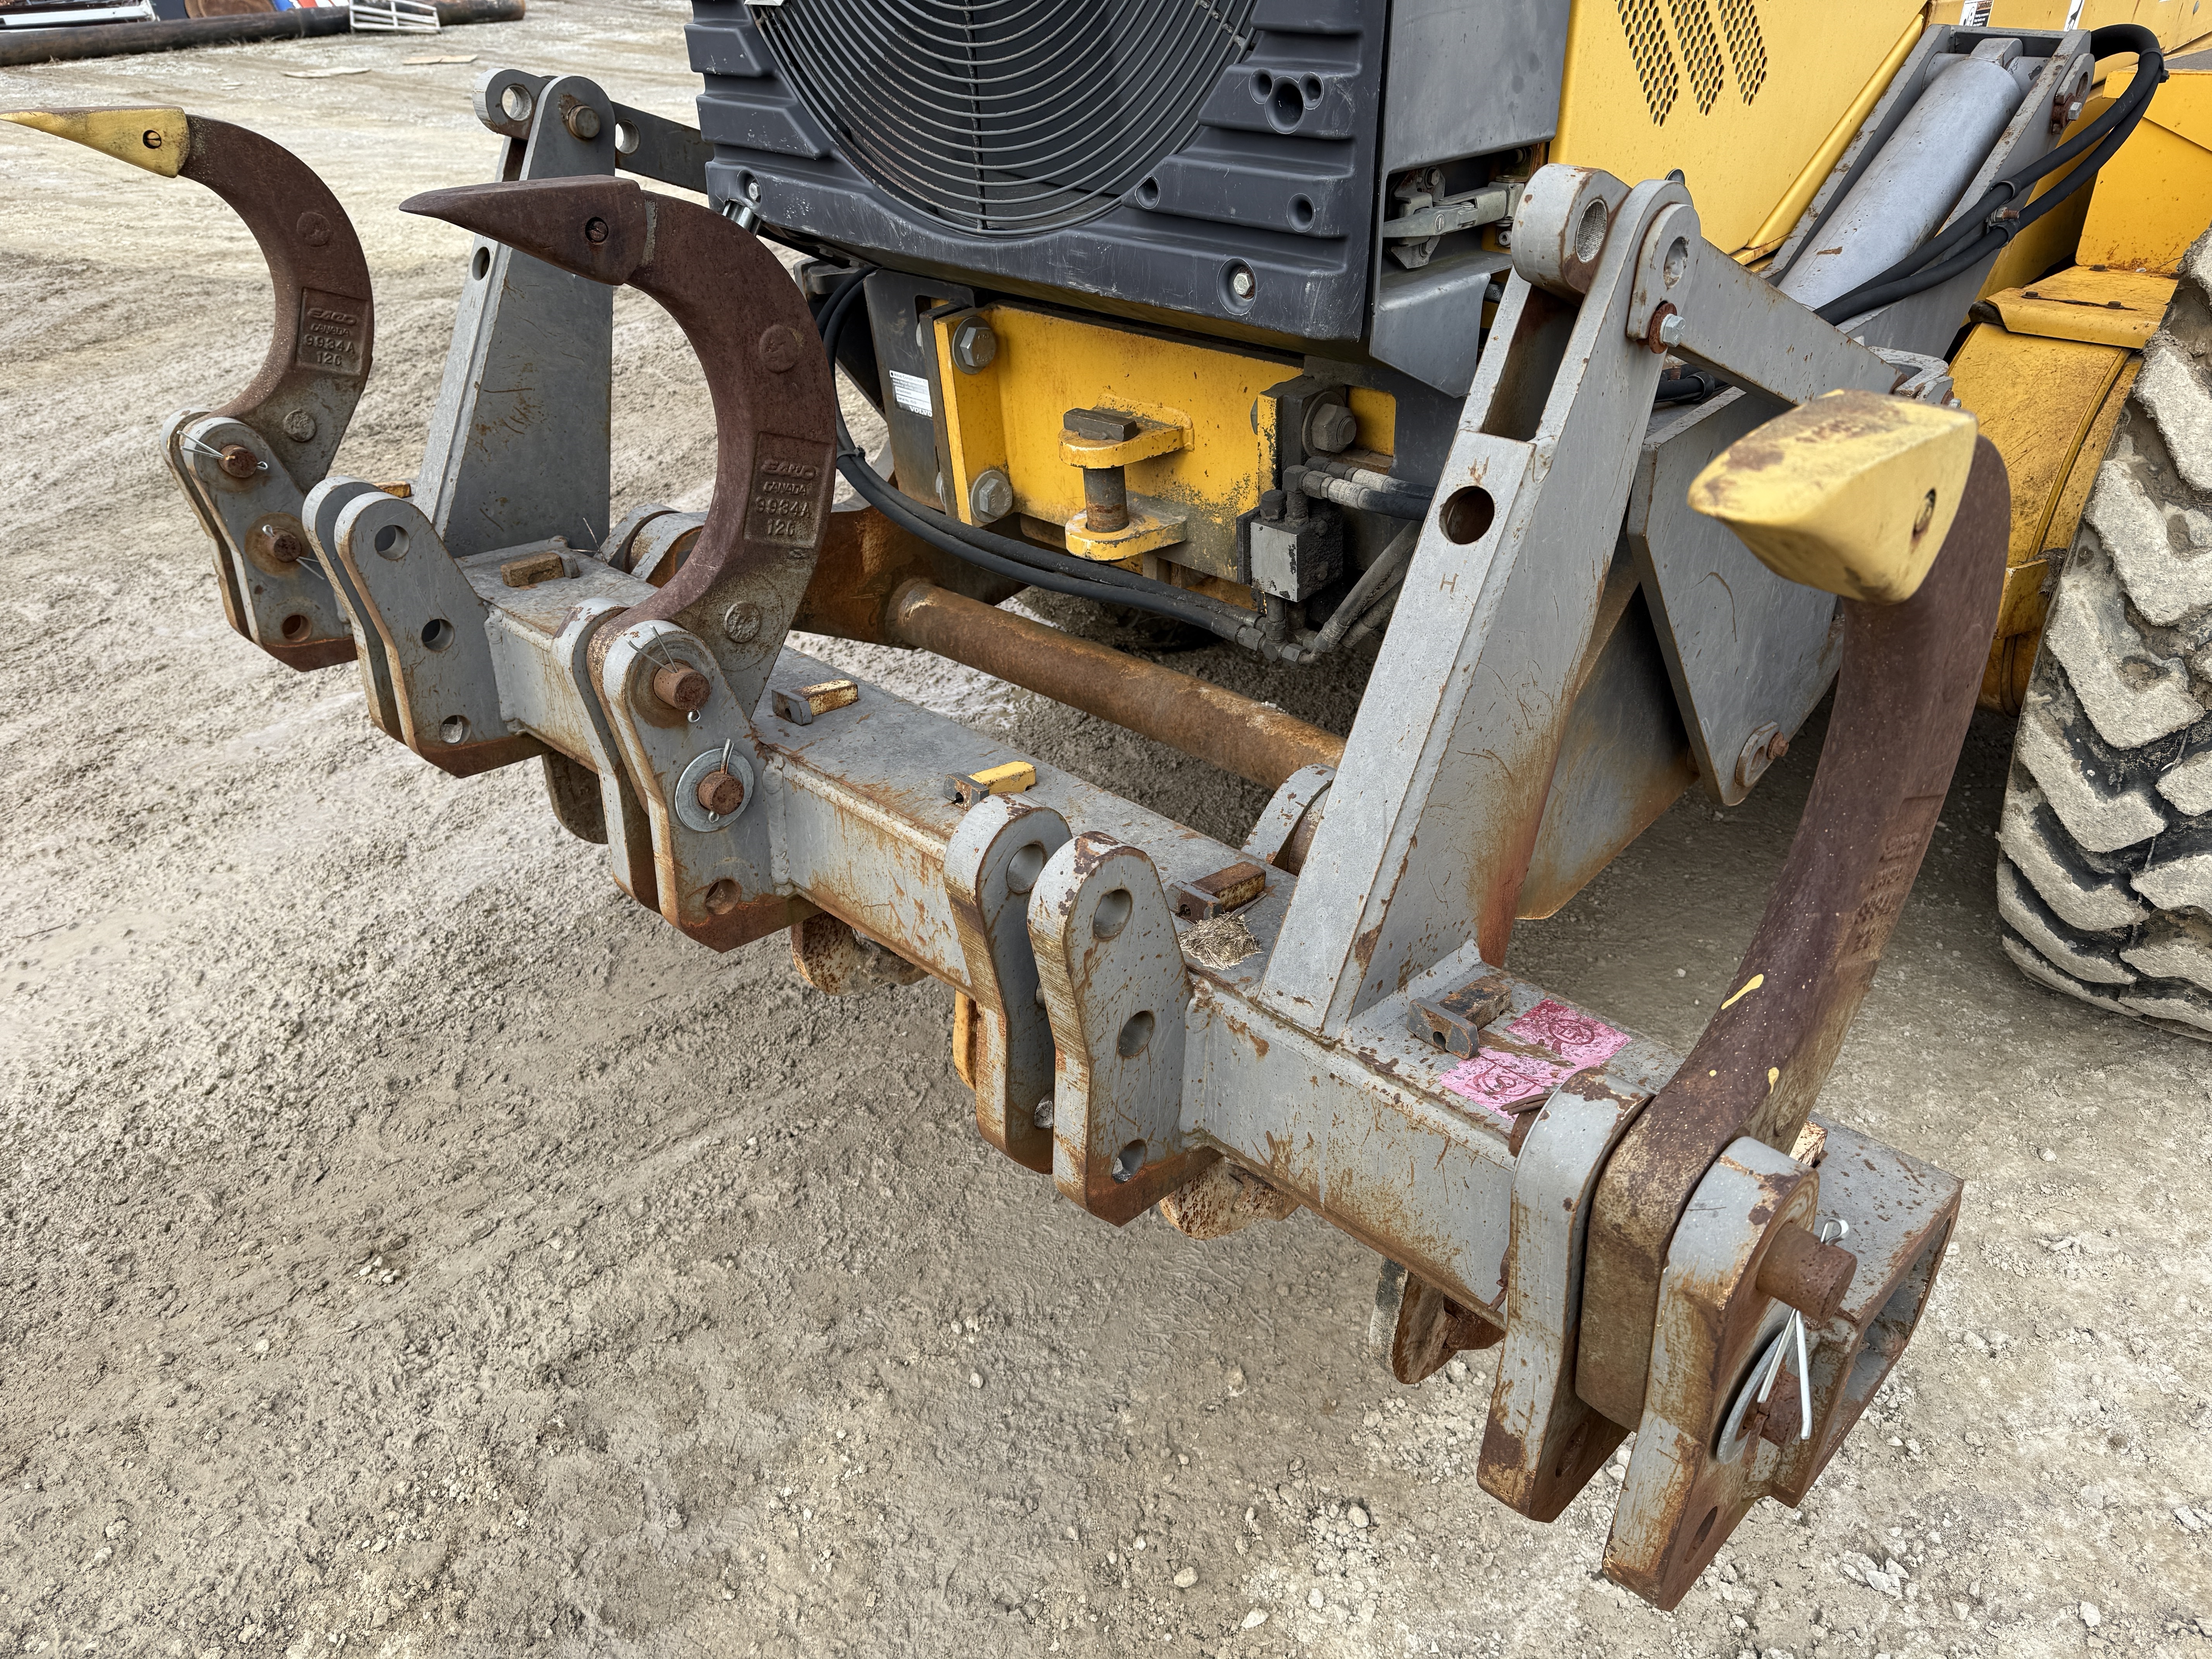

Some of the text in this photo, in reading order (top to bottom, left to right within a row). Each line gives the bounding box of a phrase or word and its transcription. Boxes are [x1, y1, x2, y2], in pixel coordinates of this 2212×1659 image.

[311, 323, 350, 337] CANADA
[304, 334, 355, 354] 9934A
[909, 405, 933, 417] VOLVO
[763, 481, 806, 496] CANADA
[1439, 573, 1459, 594] H
